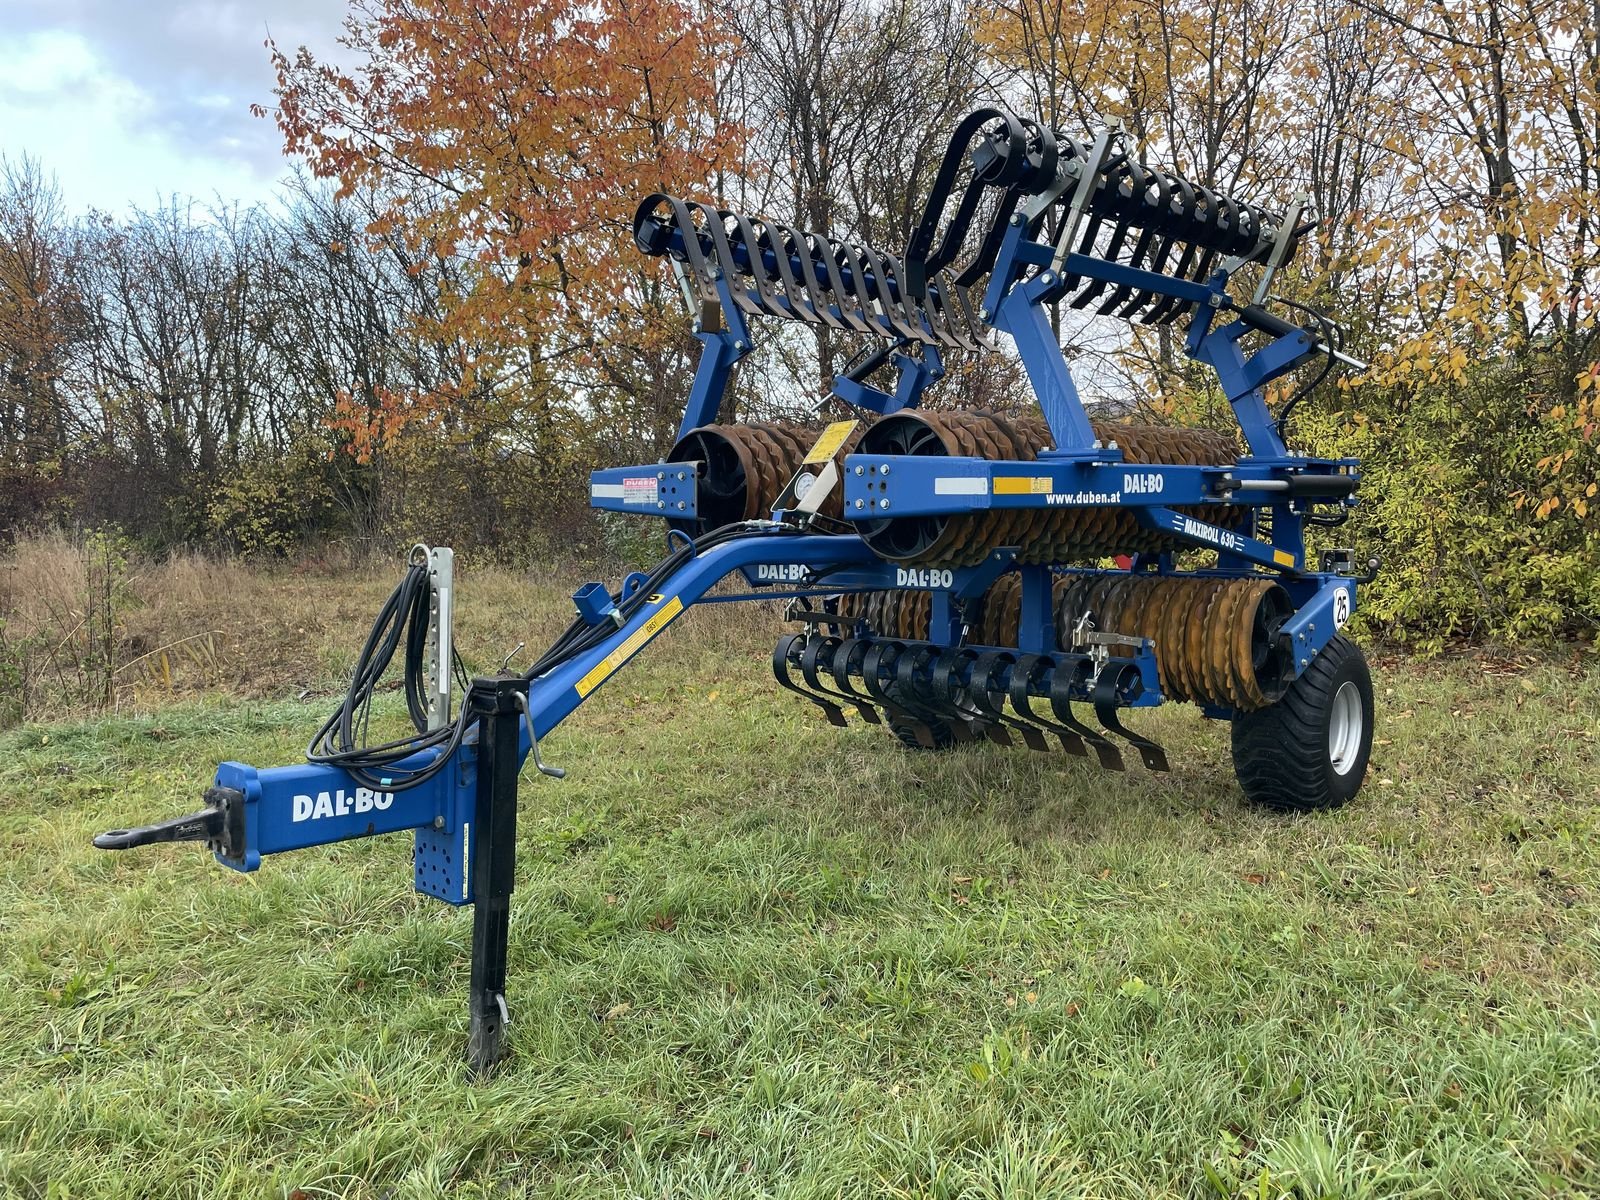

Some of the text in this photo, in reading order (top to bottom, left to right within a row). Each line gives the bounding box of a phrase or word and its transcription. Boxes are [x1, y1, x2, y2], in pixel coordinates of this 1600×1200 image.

[625, 479, 657, 487] DUBEN
[1046, 490, 1121, 505] www.duben.at
[1184, 518, 1235, 549] MAXIROLL 630
[1336, 595, 1347, 624] 25
